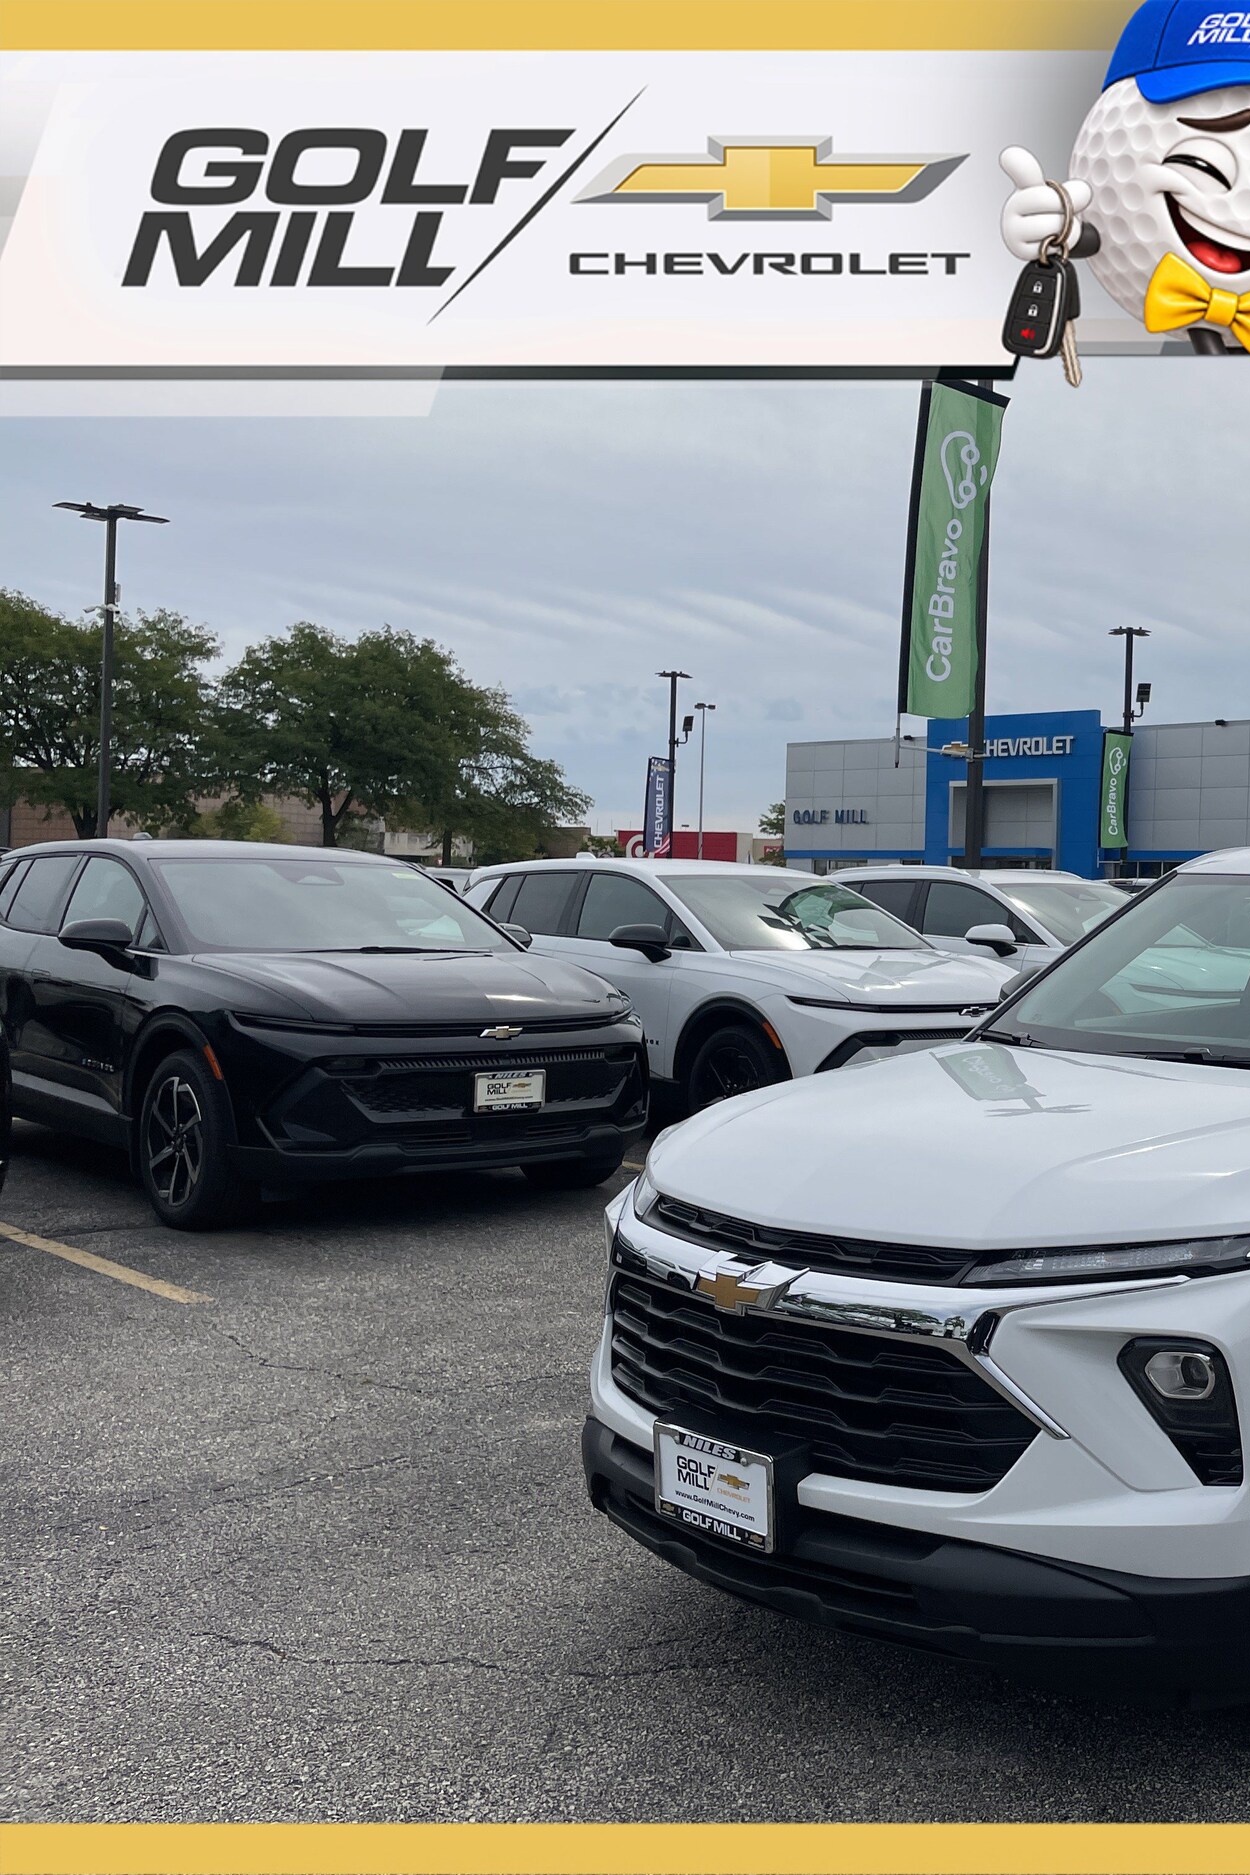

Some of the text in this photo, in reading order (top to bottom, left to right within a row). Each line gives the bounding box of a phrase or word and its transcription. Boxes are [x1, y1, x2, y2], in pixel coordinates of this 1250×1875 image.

[925, 518, 963, 682] CarBravo
[983, 735, 1074, 757] HEVROLET
[654, 774, 665, 849] CHEVROLET
[793, 809, 869, 824] GOLF MILL
[1107, 778, 1118, 835] CarBravo
[487, 1082, 512, 1090] GOLF
[683, 1434, 738, 1460] NILES
[677, 1455, 716, 1478] GOLF
[677, 1468, 710, 1491] MILL
[675, 1489, 755, 1523] www.GolfMillChevy.com
[682, 1509, 742, 1541] GOLF MILL
